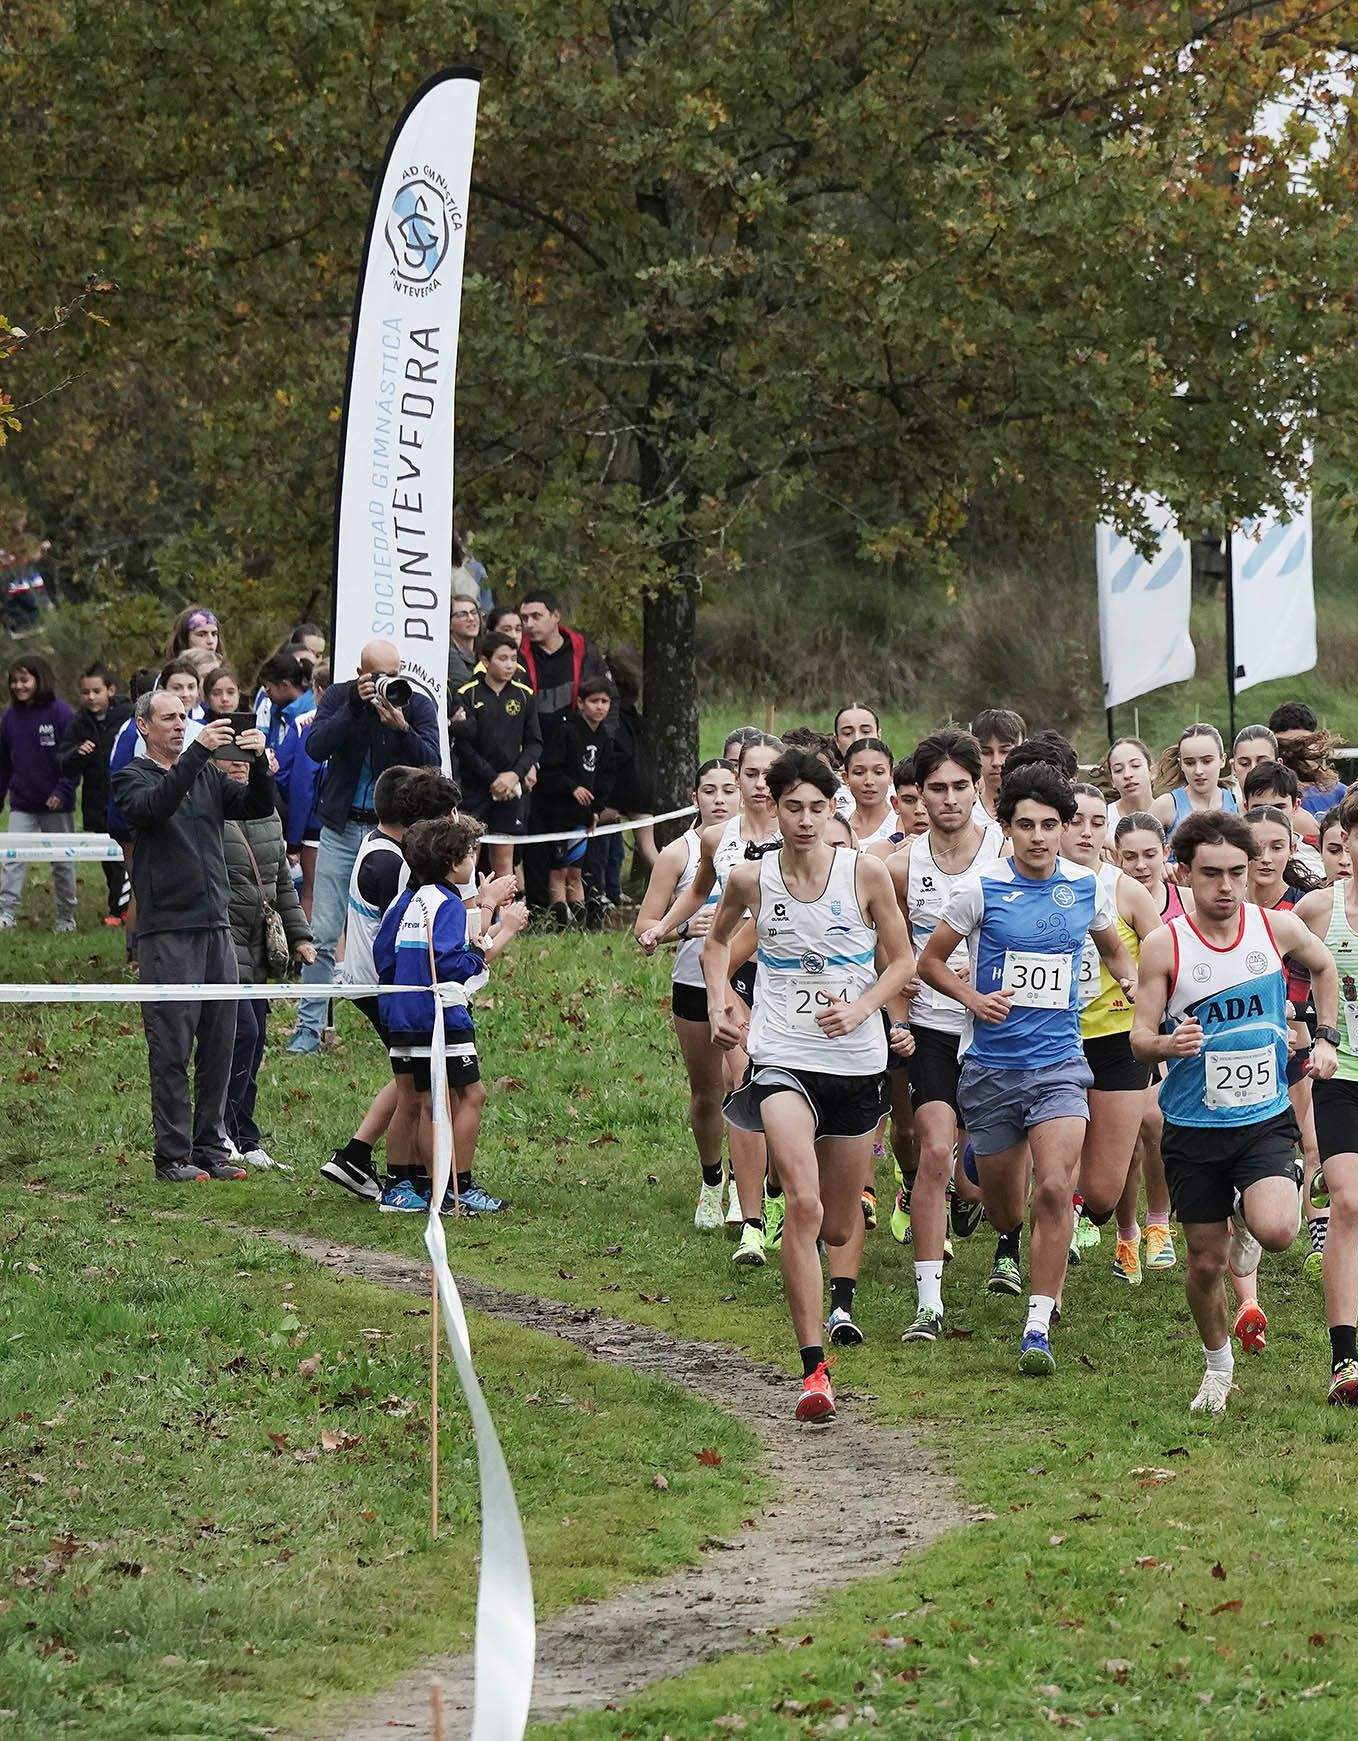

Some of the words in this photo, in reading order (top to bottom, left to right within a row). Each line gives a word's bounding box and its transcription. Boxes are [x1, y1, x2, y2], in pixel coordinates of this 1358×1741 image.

[368, 500, 395, 636] SOCIEDAD
[1011, 965, 1061, 991] 301
[1216, 1060, 1270, 1089] 295
